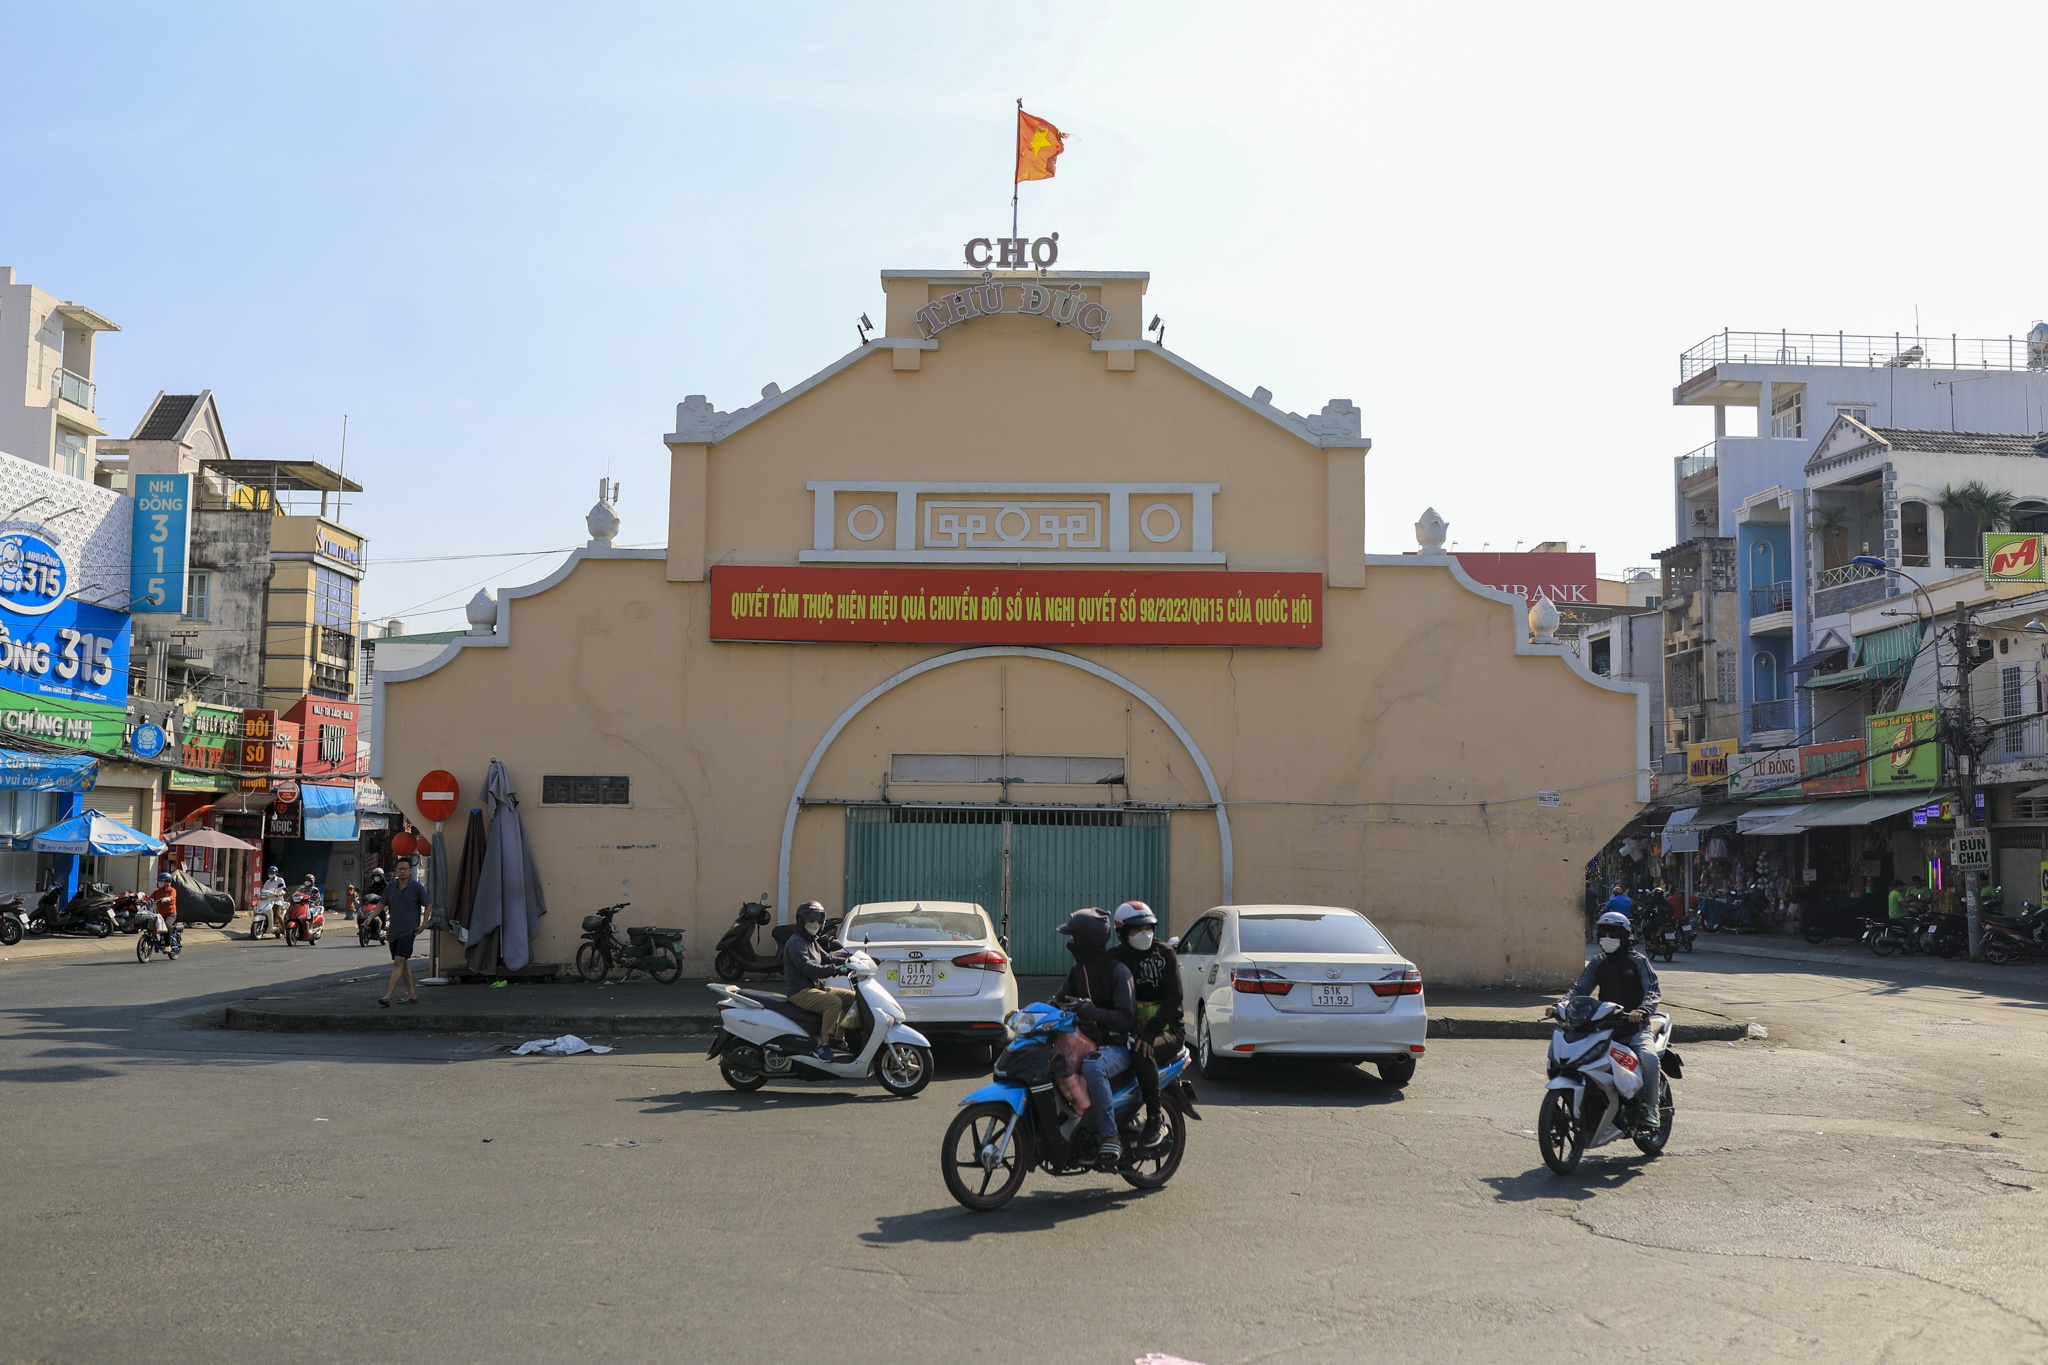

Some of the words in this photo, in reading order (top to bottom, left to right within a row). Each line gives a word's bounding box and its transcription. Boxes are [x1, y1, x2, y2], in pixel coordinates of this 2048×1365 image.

[965, 232, 1059, 277] CHỢ
[916, 271, 1004, 335] THỦ
[1018, 283, 1110, 334] ĐỨC
[149, 480, 174, 493] NHI
[139, 493, 183, 511] ĐỒNG
[27, 551, 41, 562] NHI
[42, 552, 60, 567] ĐỒNG
[24, 562, 61, 598] 315
[731, 585, 769, 620] QUYẾT
[773, 588, 799, 618] TÂM
[803, 592, 834, 624] THỰC
[837, 590, 866, 625] HIỆN
[870, 590, 898, 625] HIỆU
[901, 587, 926, 623] QUẢ
[929, 586, 978, 621] CHUYỂN
[981, 586, 1002, 621] ĐỔI
[1006, 588, 1022, 622] SỐ
[1026, 591, 1042, 622] VÀ
[1045, 597, 1075, 627] NGHỊ
[1078, 590, 1117, 624] QUYẾT
[1120, 589, 1137, 623] SỐ
[1140, 597, 1224, 625] 98/2023/QH15
[1227, 590, 1252, 623] CỦA
[1255, 590, 1288, 625] QUỐC
[1292, 594, 1313, 629] HỘI
[56, 628, 113, 686] 315
[5, 707, 63, 736] CHỦNG
[66, 718, 92, 740] NHI
[196, 715, 209, 734] ĐẠI
[210, 715, 219, 732] LÝ
[246, 714, 269, 737] ĐỔI
[6, 756, 25, 769] của
[1769, 753, 1796, 777] ĐỒNG
[5, 775, 20, 785] vui
[22, 774, 38, 786] của
[1914, 814, 1926, 823] MPE
[270, 820, 293, 834] NGỌC
[1959, 836, 1986, 852] BÚN
[1959, 850, 1988, 865] CHAY
[907, 964, 925, 975] 61A
[1323, 987, 1341, 996] 61K
[1317, 995, 1349, 1006] 131.92
